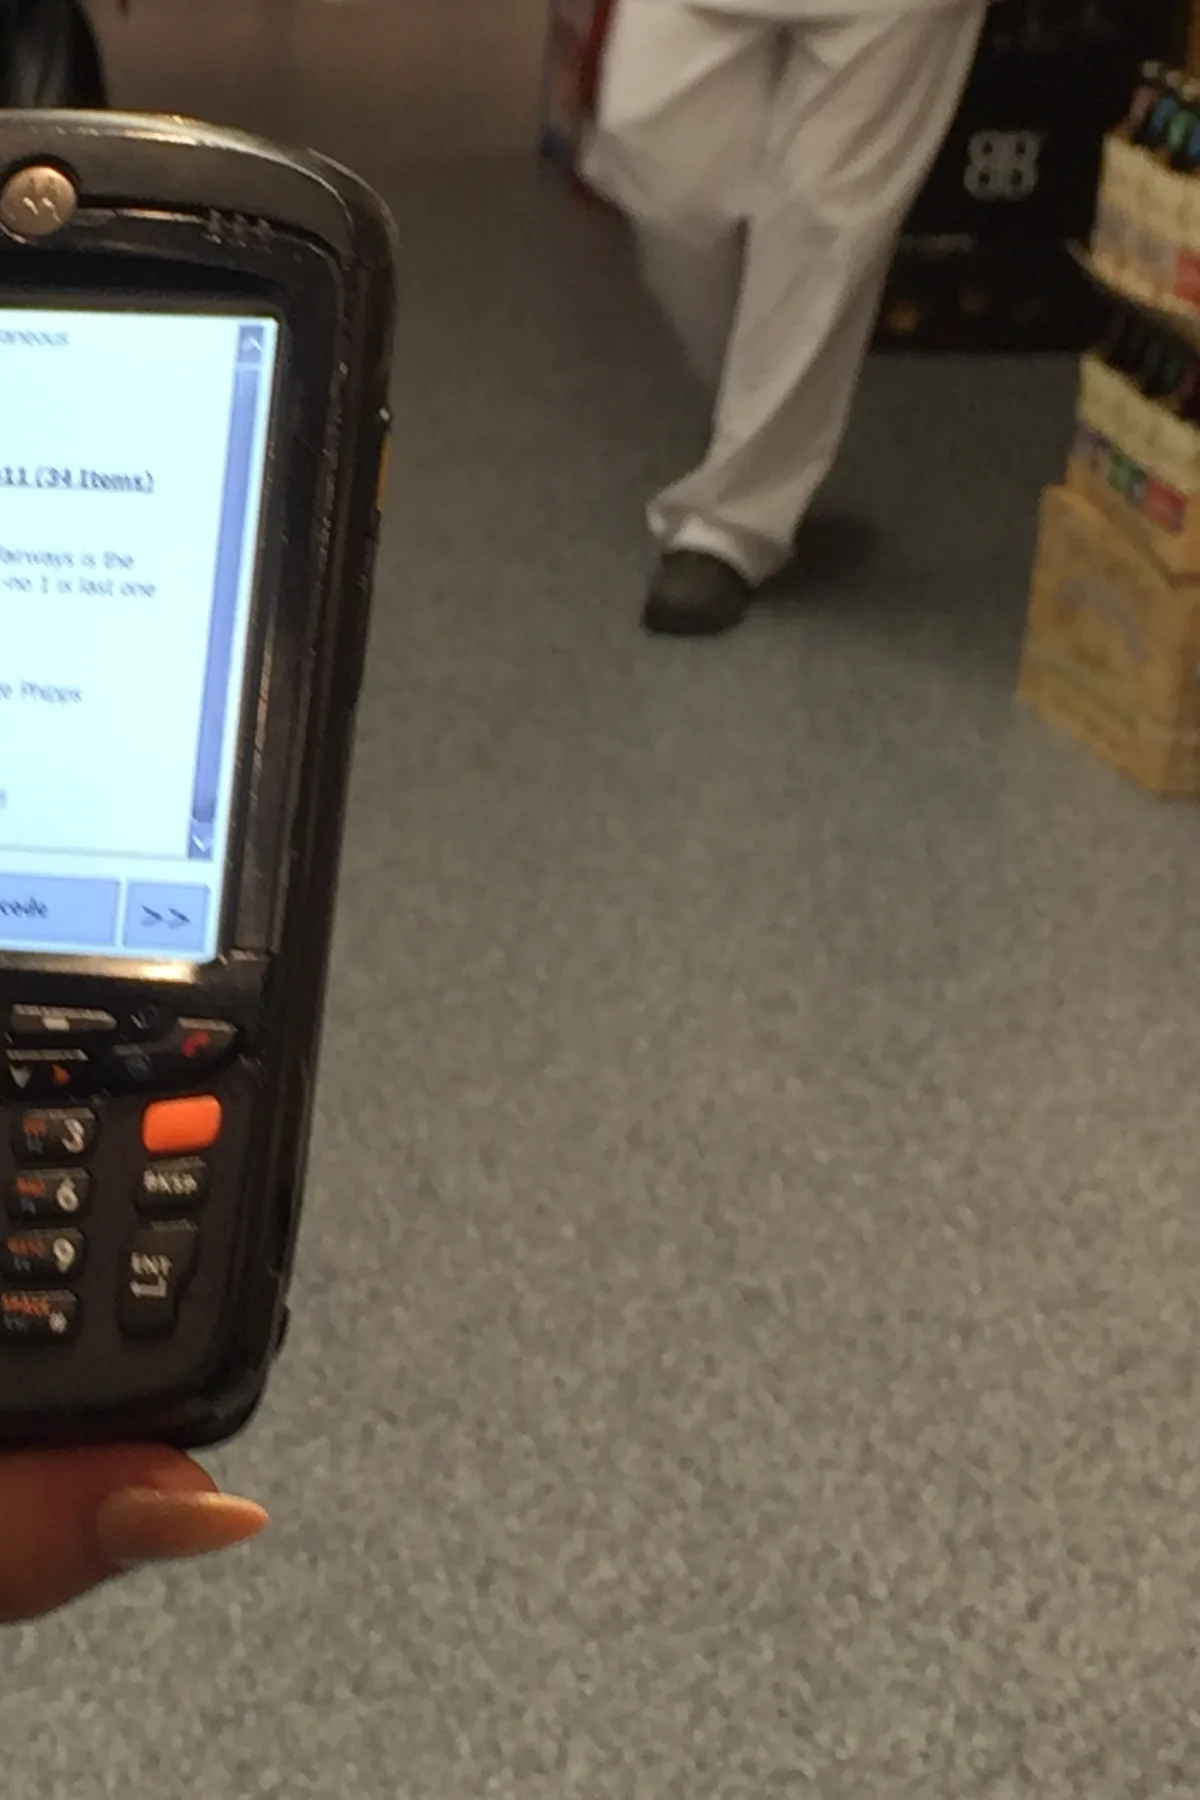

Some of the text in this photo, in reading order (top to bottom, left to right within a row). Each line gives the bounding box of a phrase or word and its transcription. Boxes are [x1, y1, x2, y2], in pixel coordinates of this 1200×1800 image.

[80, 468, 154, 493] Items)
[81, 550, 96, 569] is
[103, 549, 134, 569] the
[57, 578, 73, 594] is
[79, 575, 114, 597] last
[120, 581, 157, 598] one
[62, 1118, 85, 1153] 3
[56, 1176, 79, 1212] 6
[53, 1237, 75, 1273] 9
